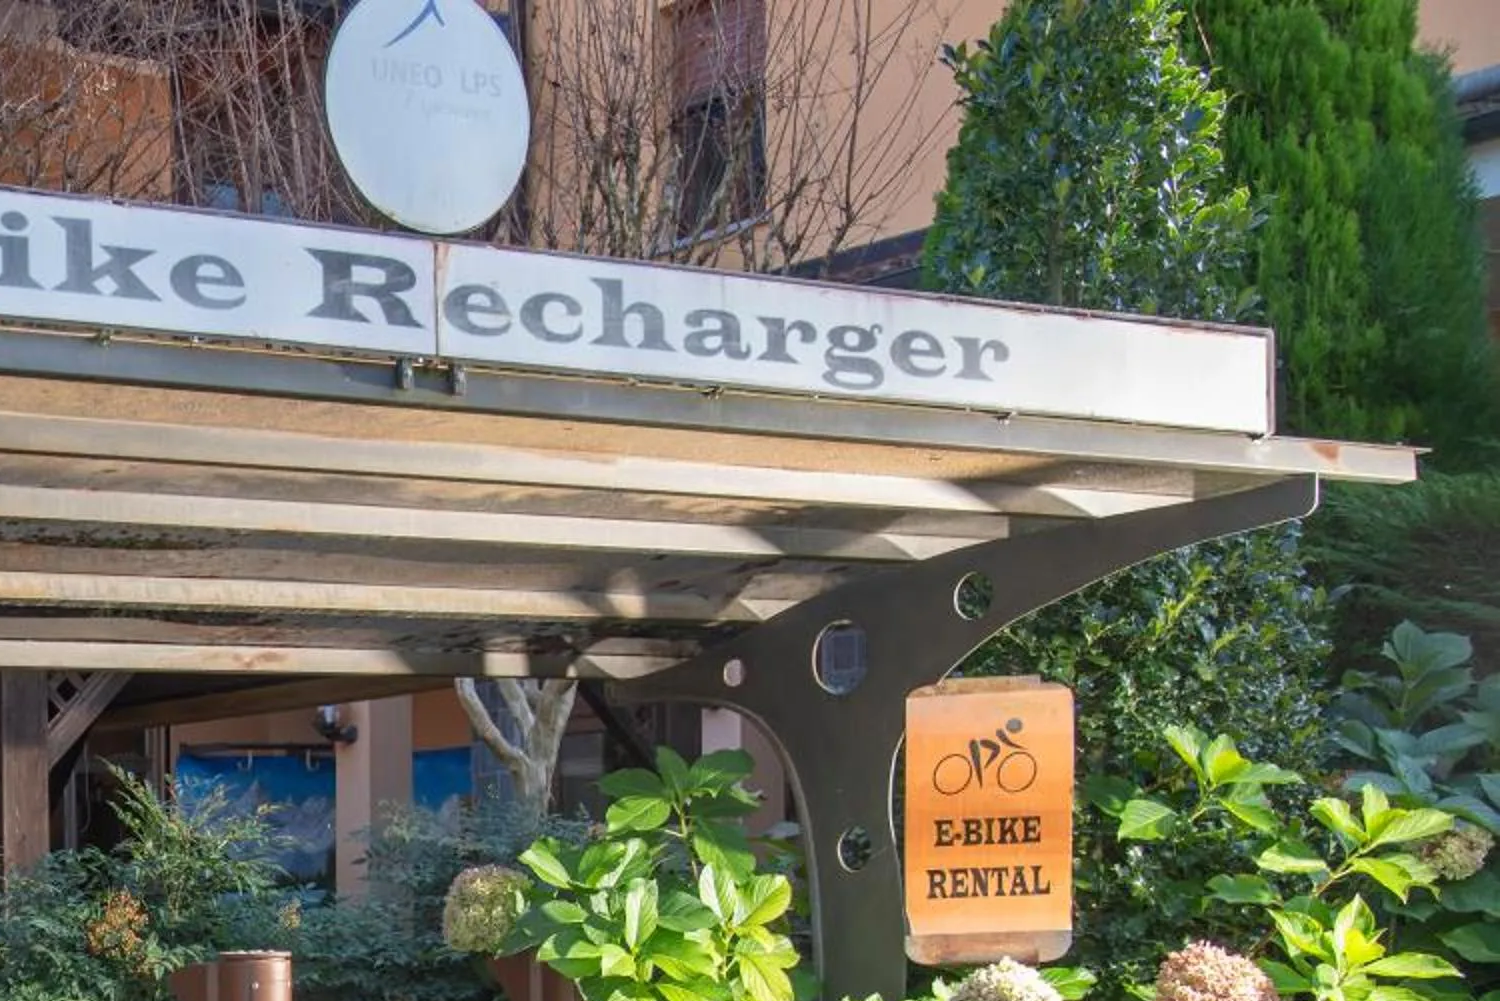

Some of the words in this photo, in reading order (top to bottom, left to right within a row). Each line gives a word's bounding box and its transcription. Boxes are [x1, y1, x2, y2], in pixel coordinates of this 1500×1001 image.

[303, 247, 1010, 391] Recharger
[933, 815, 1042, 848] E-BIKE
[925, 865, 1051, 900] RENTAL
